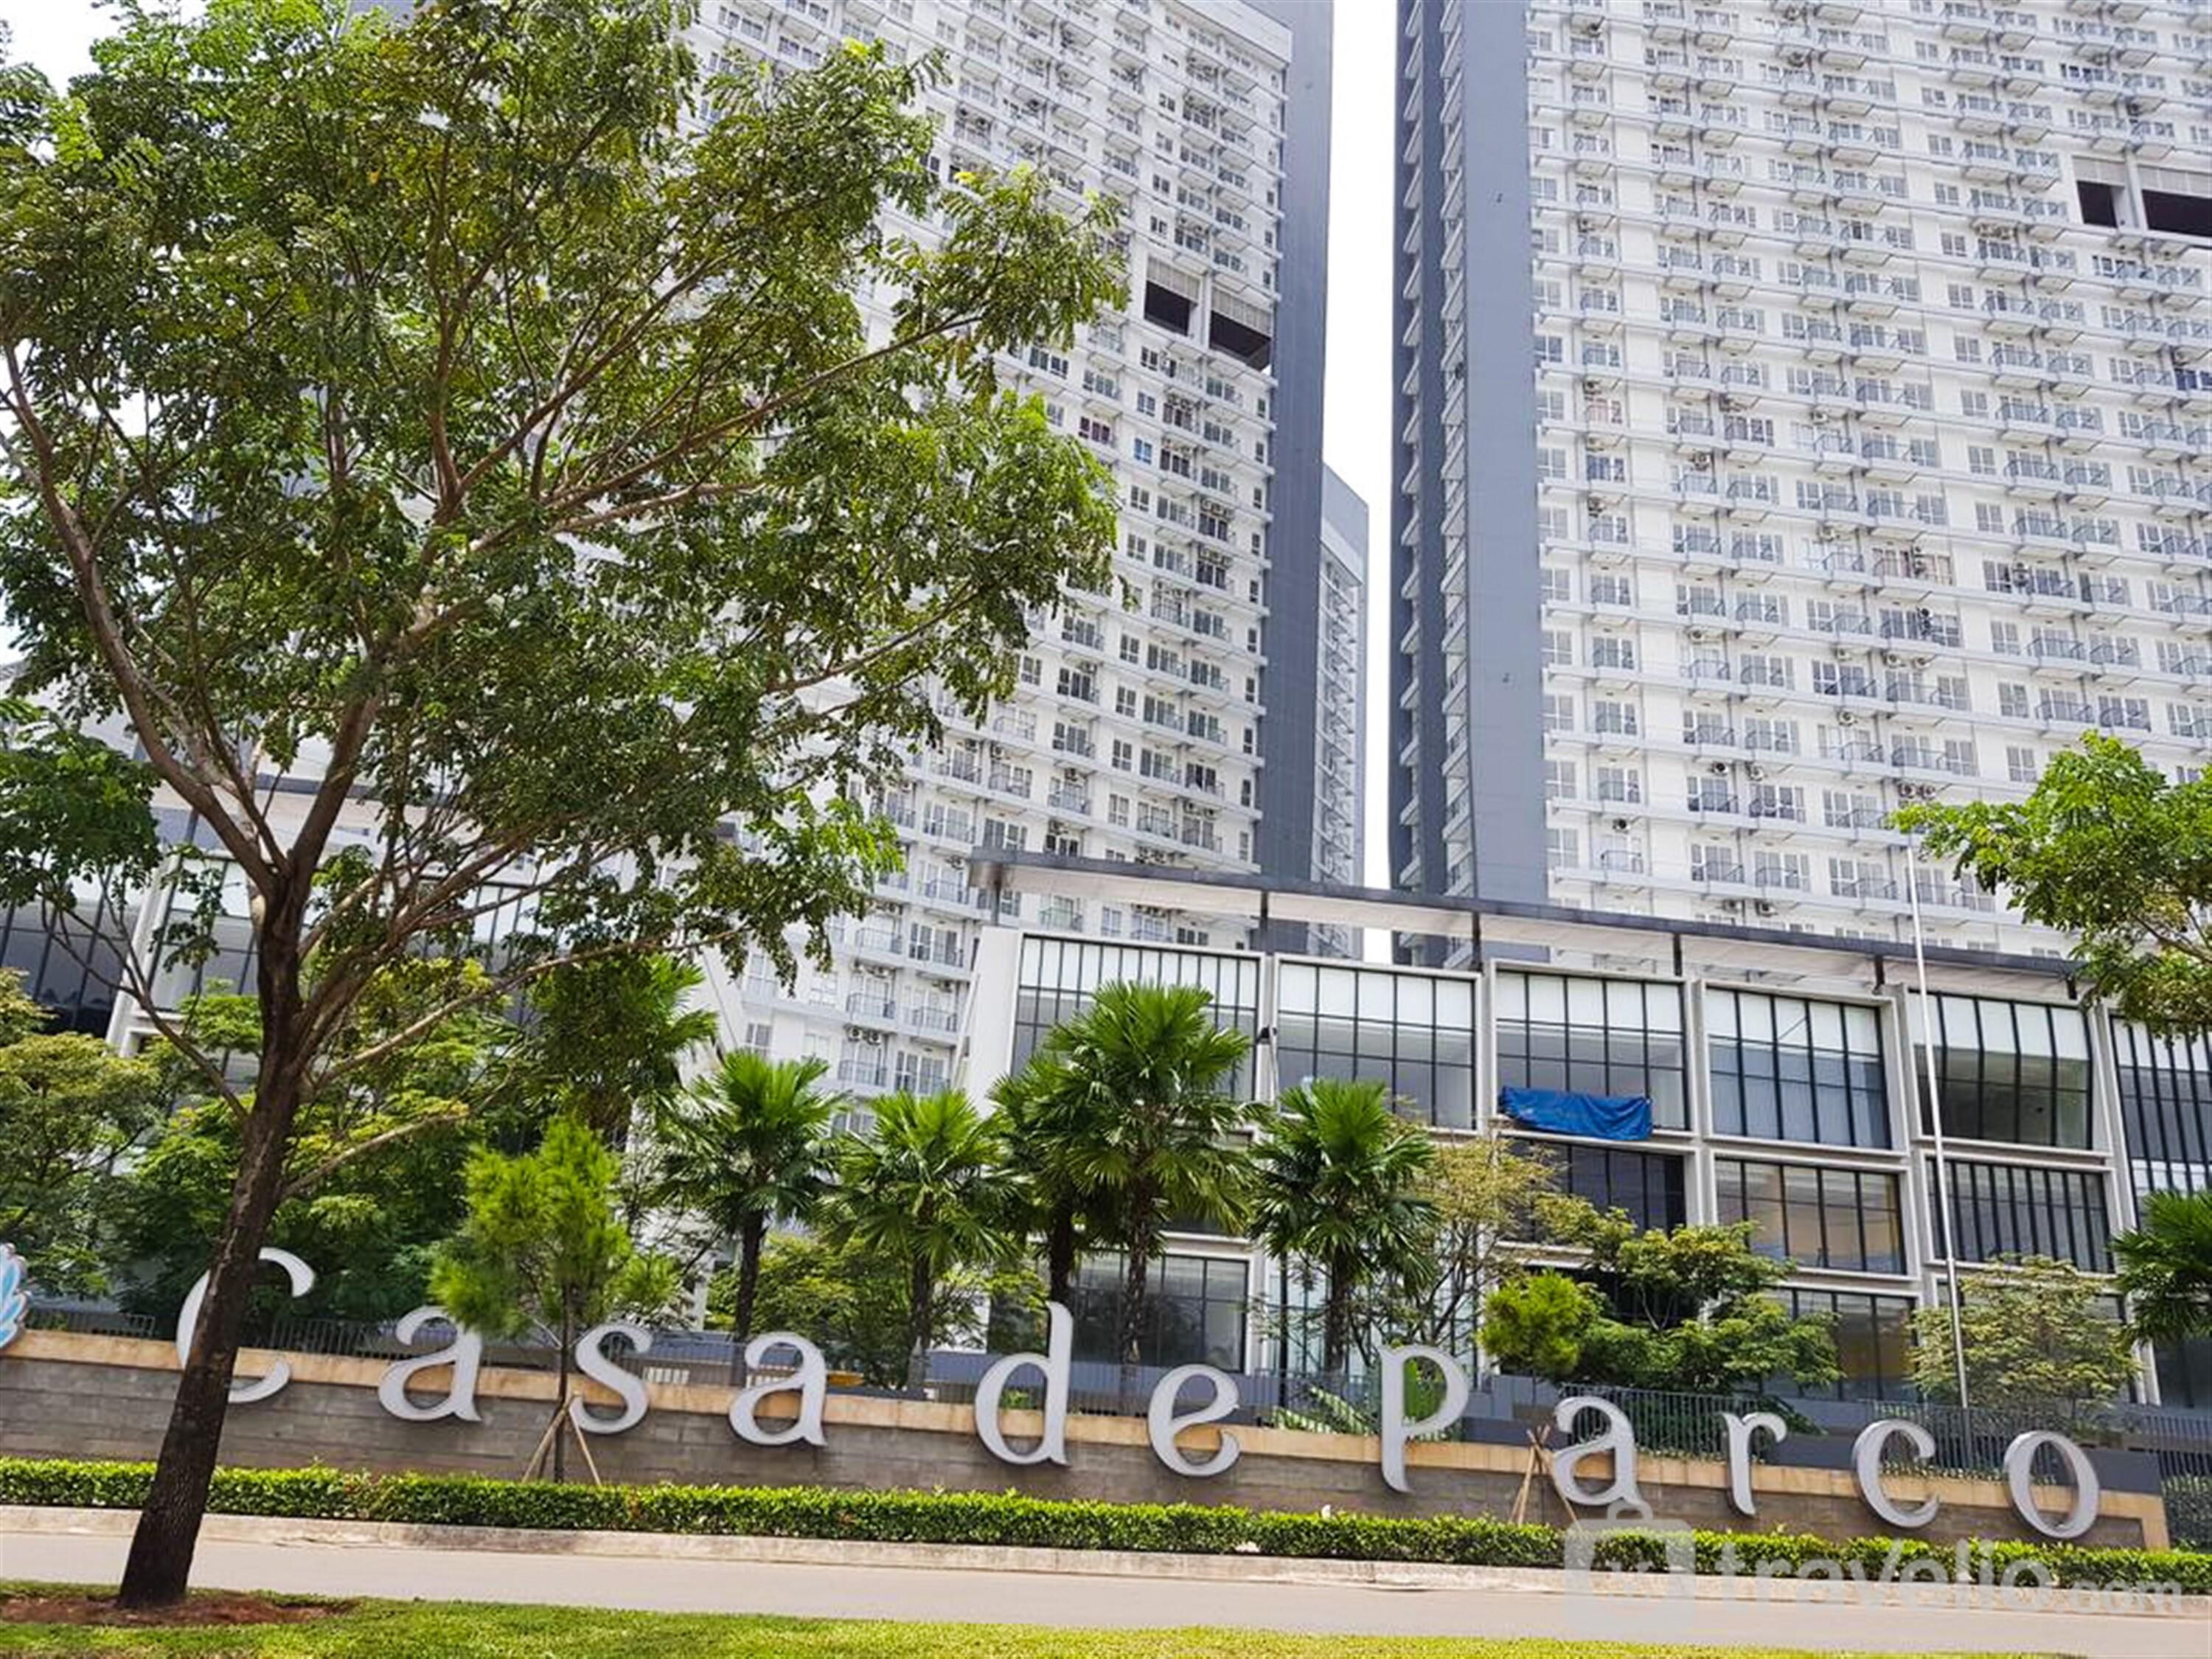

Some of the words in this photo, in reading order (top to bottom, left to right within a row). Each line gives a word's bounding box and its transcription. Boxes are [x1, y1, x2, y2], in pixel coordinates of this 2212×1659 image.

[175, 1247, 827, 1447] Casa
[974, 1301, 1242, 1478] de
[1377, 1343, 2100, 1540] Parco
